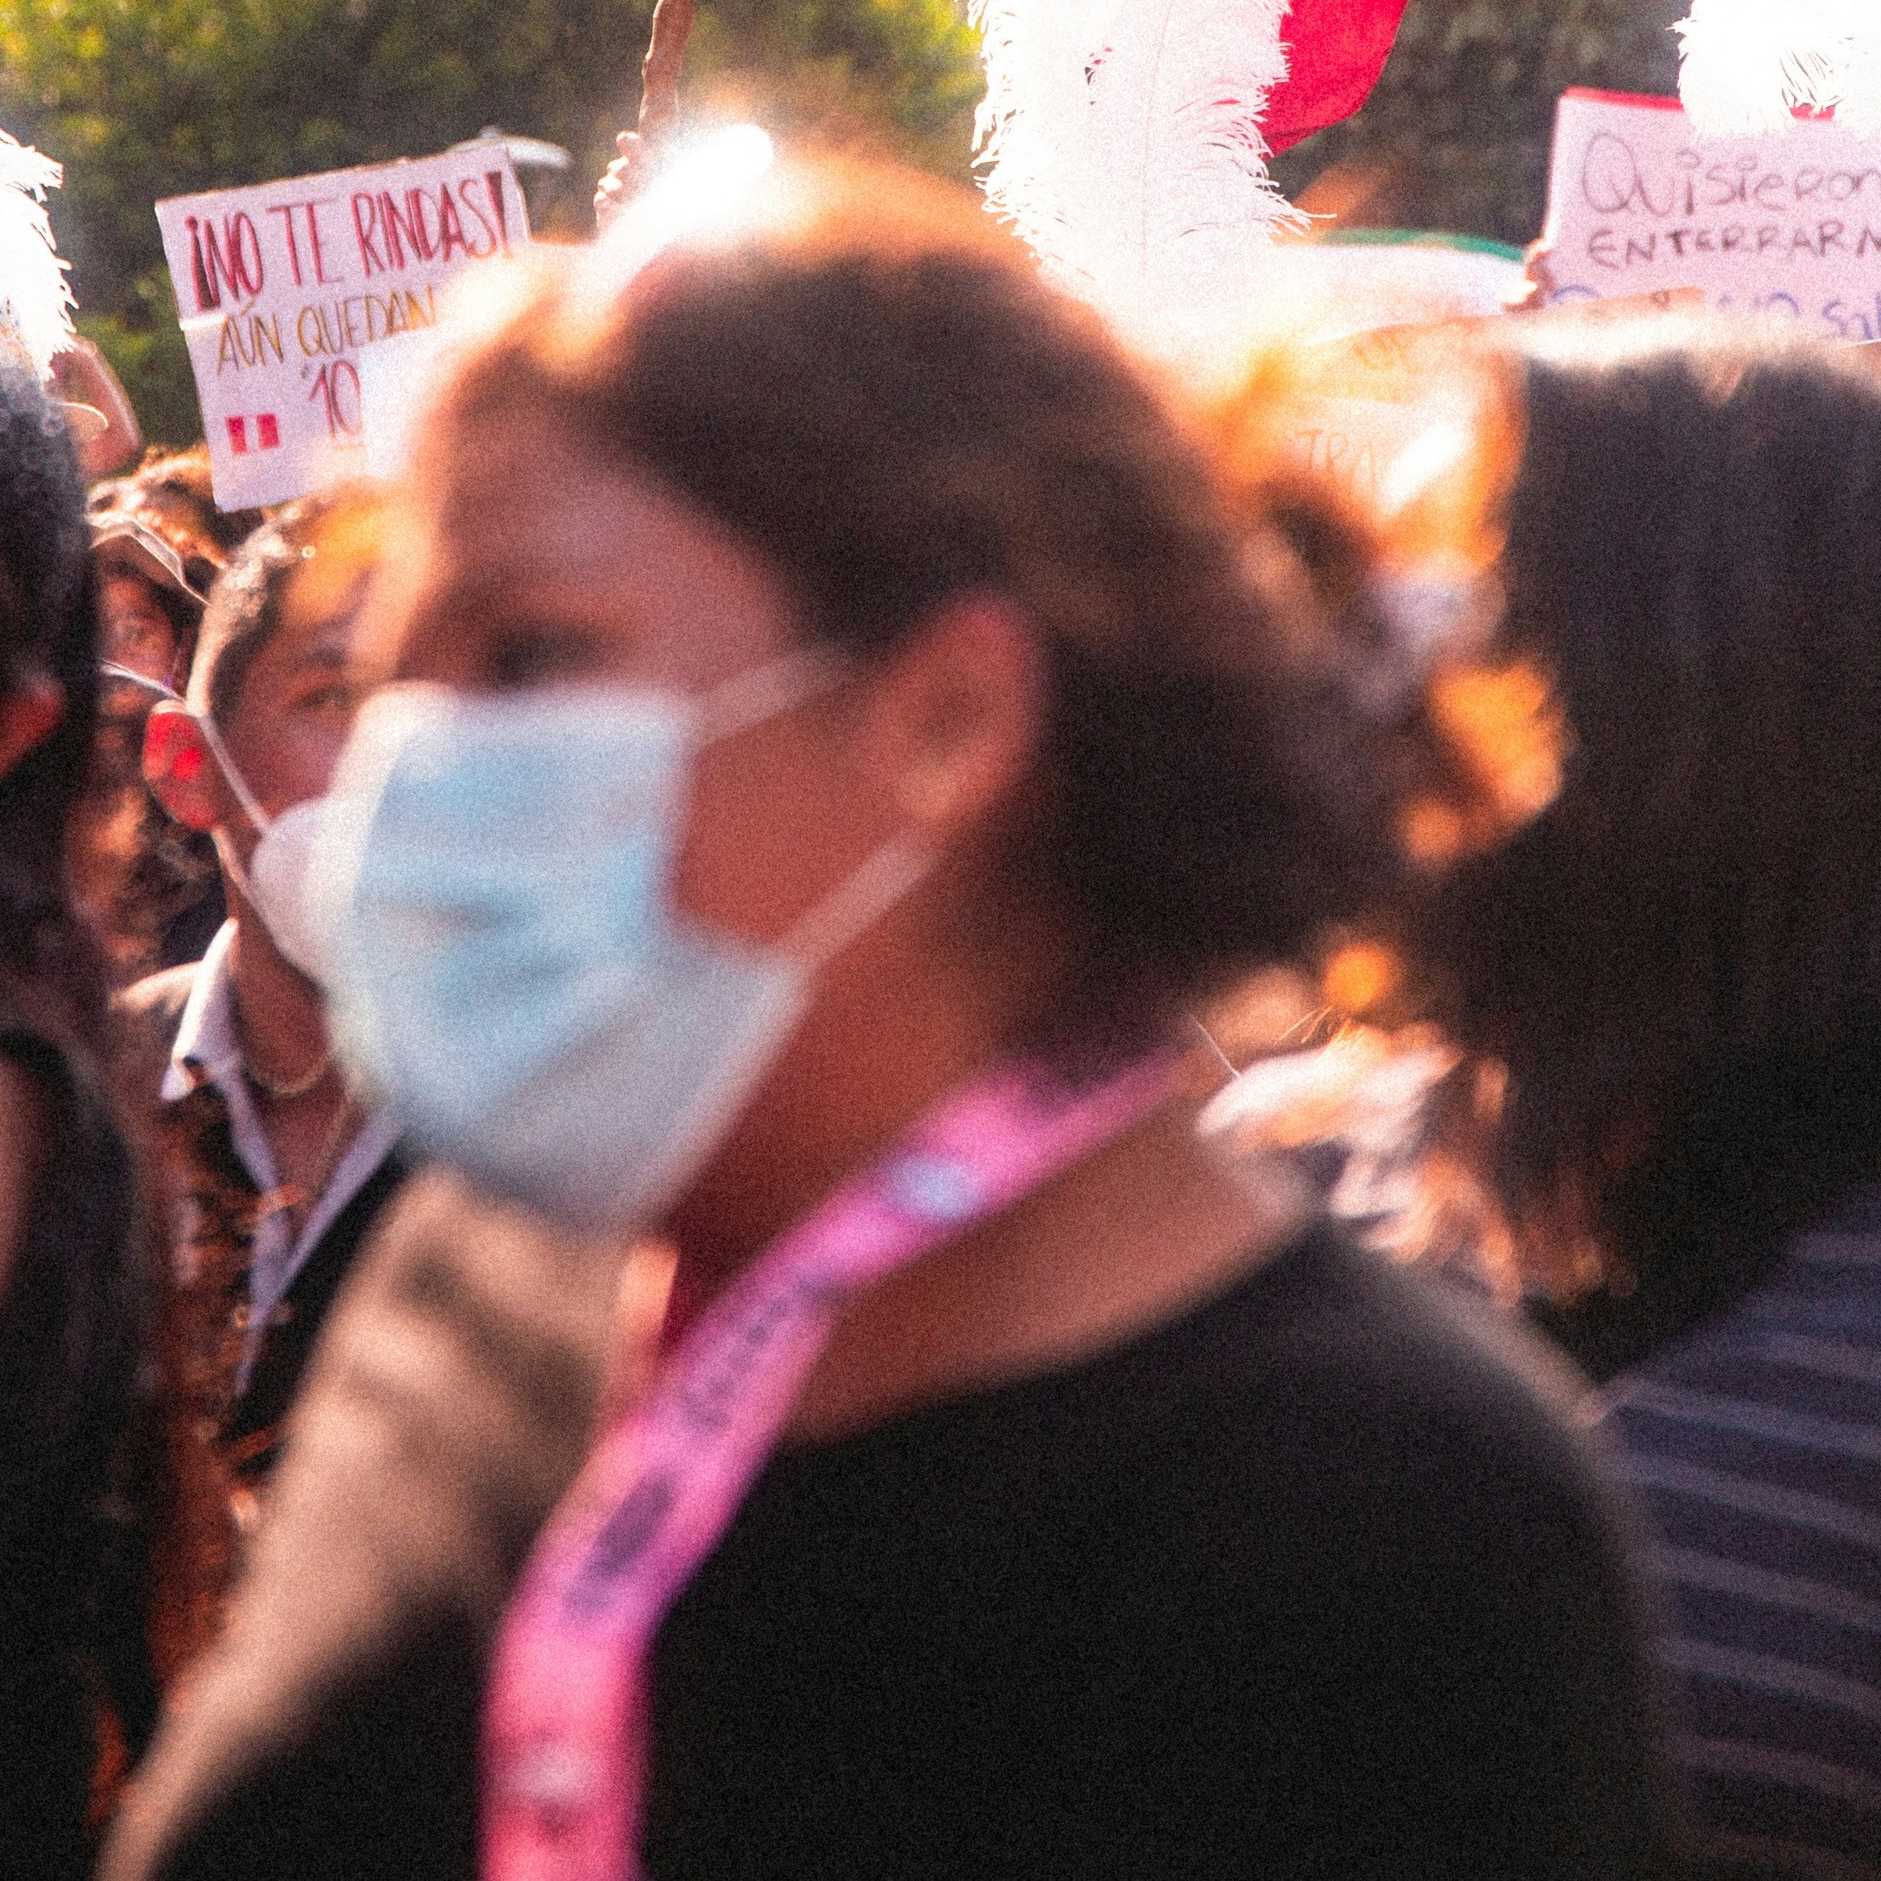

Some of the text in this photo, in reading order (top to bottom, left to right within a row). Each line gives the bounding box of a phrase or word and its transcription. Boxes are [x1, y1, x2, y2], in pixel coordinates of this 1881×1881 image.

[266, 197, 345, 287] TE
[350, 170, 516, 279] RINDAS!
[297, 283, 438, 359] QUEDAN
